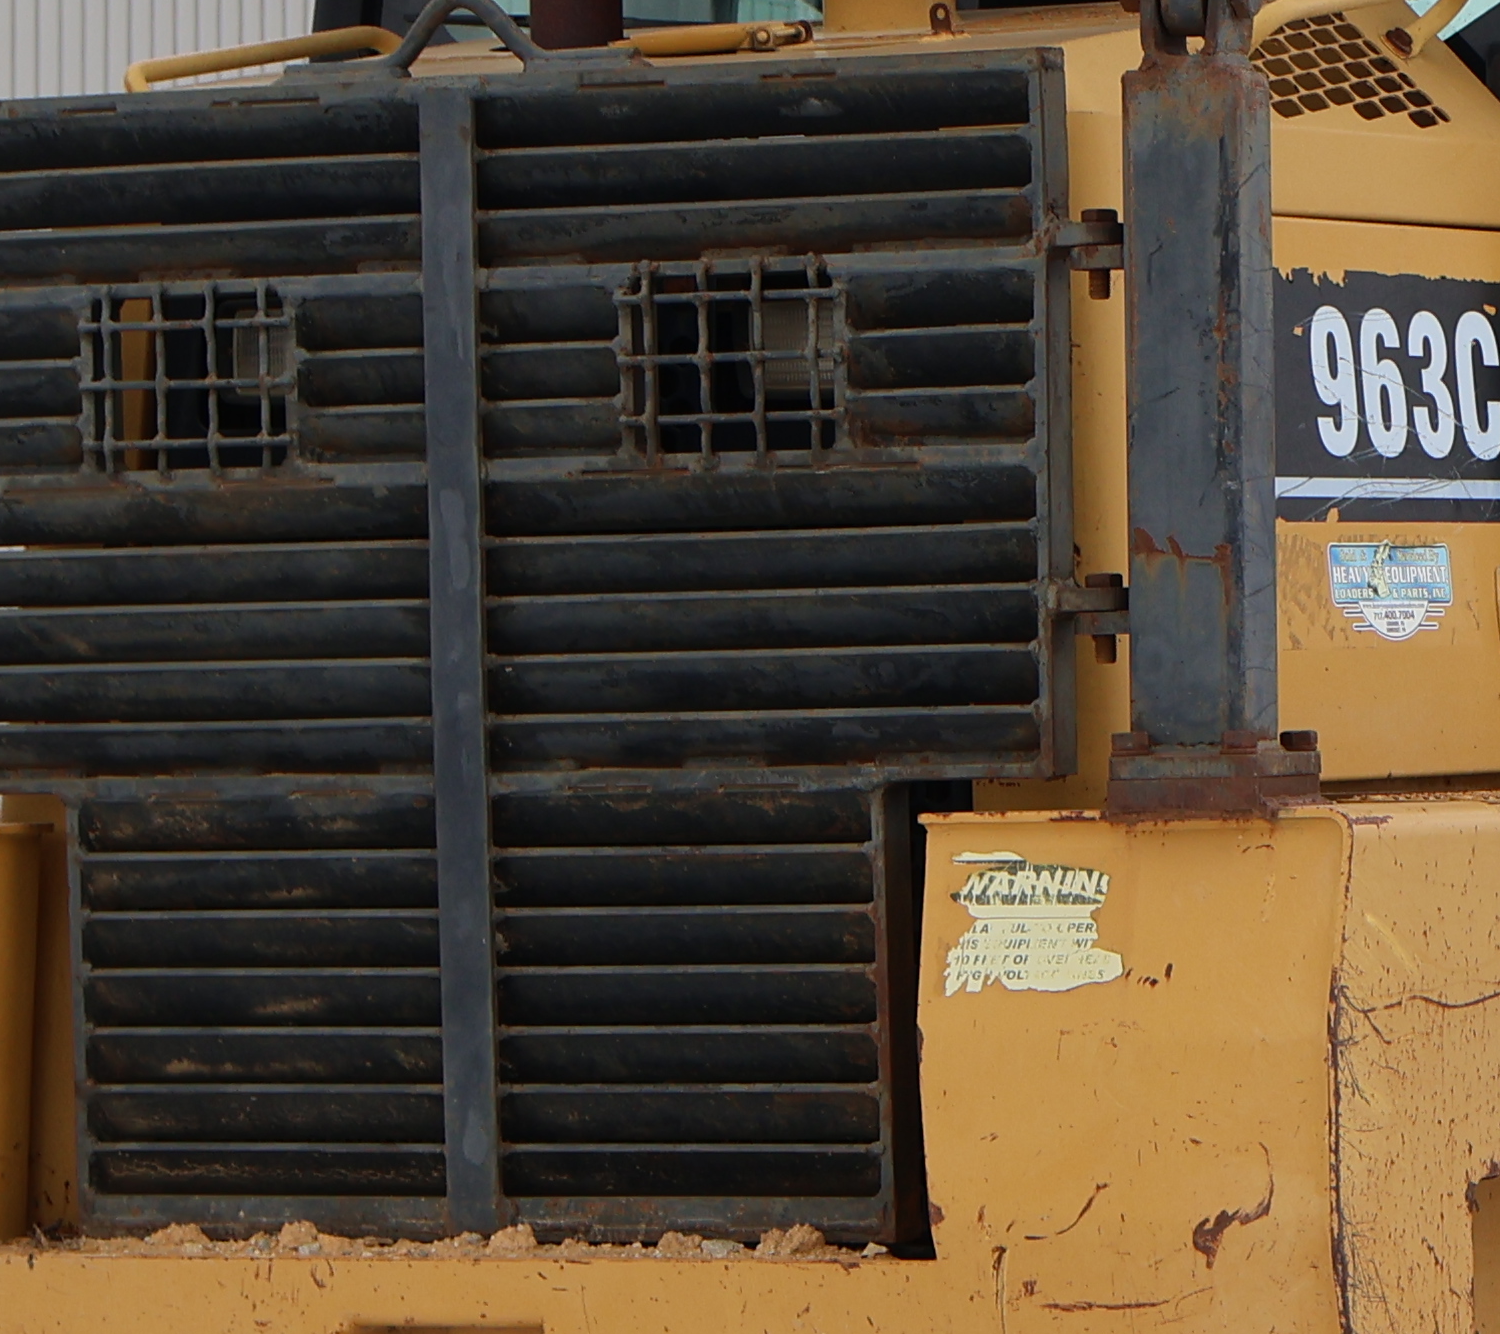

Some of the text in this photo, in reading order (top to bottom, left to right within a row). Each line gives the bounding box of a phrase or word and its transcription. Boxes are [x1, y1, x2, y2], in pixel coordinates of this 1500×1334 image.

[1332, 566, 1369, 584] HEAVY
[1335, 588, 1374, 599] LOADERS
[1392, 588, 1400, 599] &
